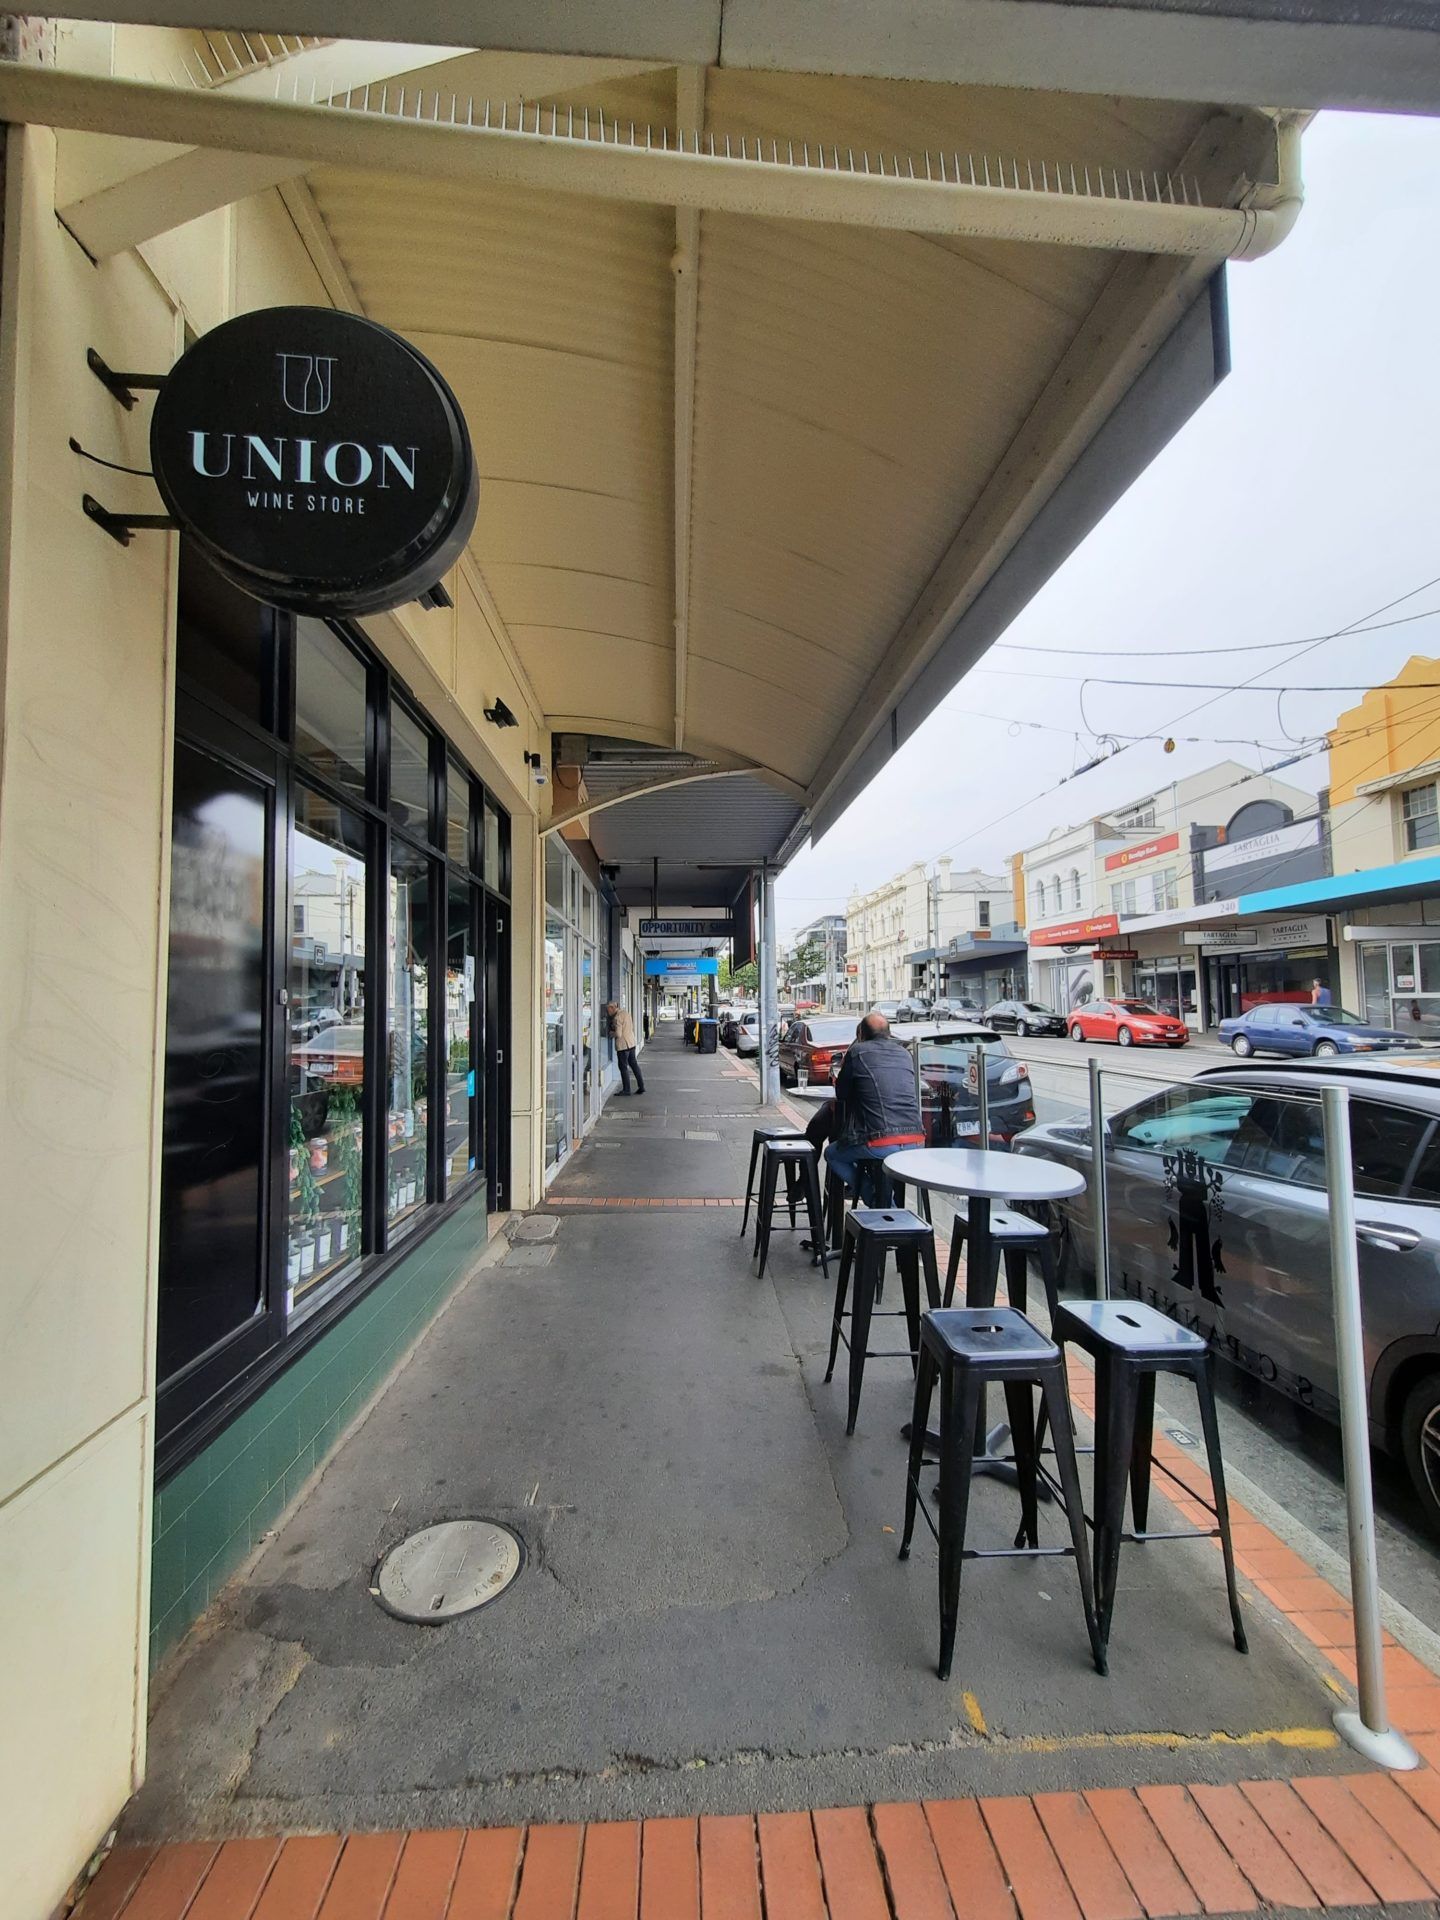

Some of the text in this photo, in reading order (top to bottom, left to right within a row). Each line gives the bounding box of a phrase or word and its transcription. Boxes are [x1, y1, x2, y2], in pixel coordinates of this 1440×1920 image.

[187, 431, 420, 490] UNION
[247, 491, 366, 515] WINE STORE
[1233, 834, 1280, 853] TARTAGLIA
[1219, 901, 1236, 913] 240
[642, 922, 705, 934] OPPORTUNITY
[1272, 924, 1308, 935] TARTAGLIA
